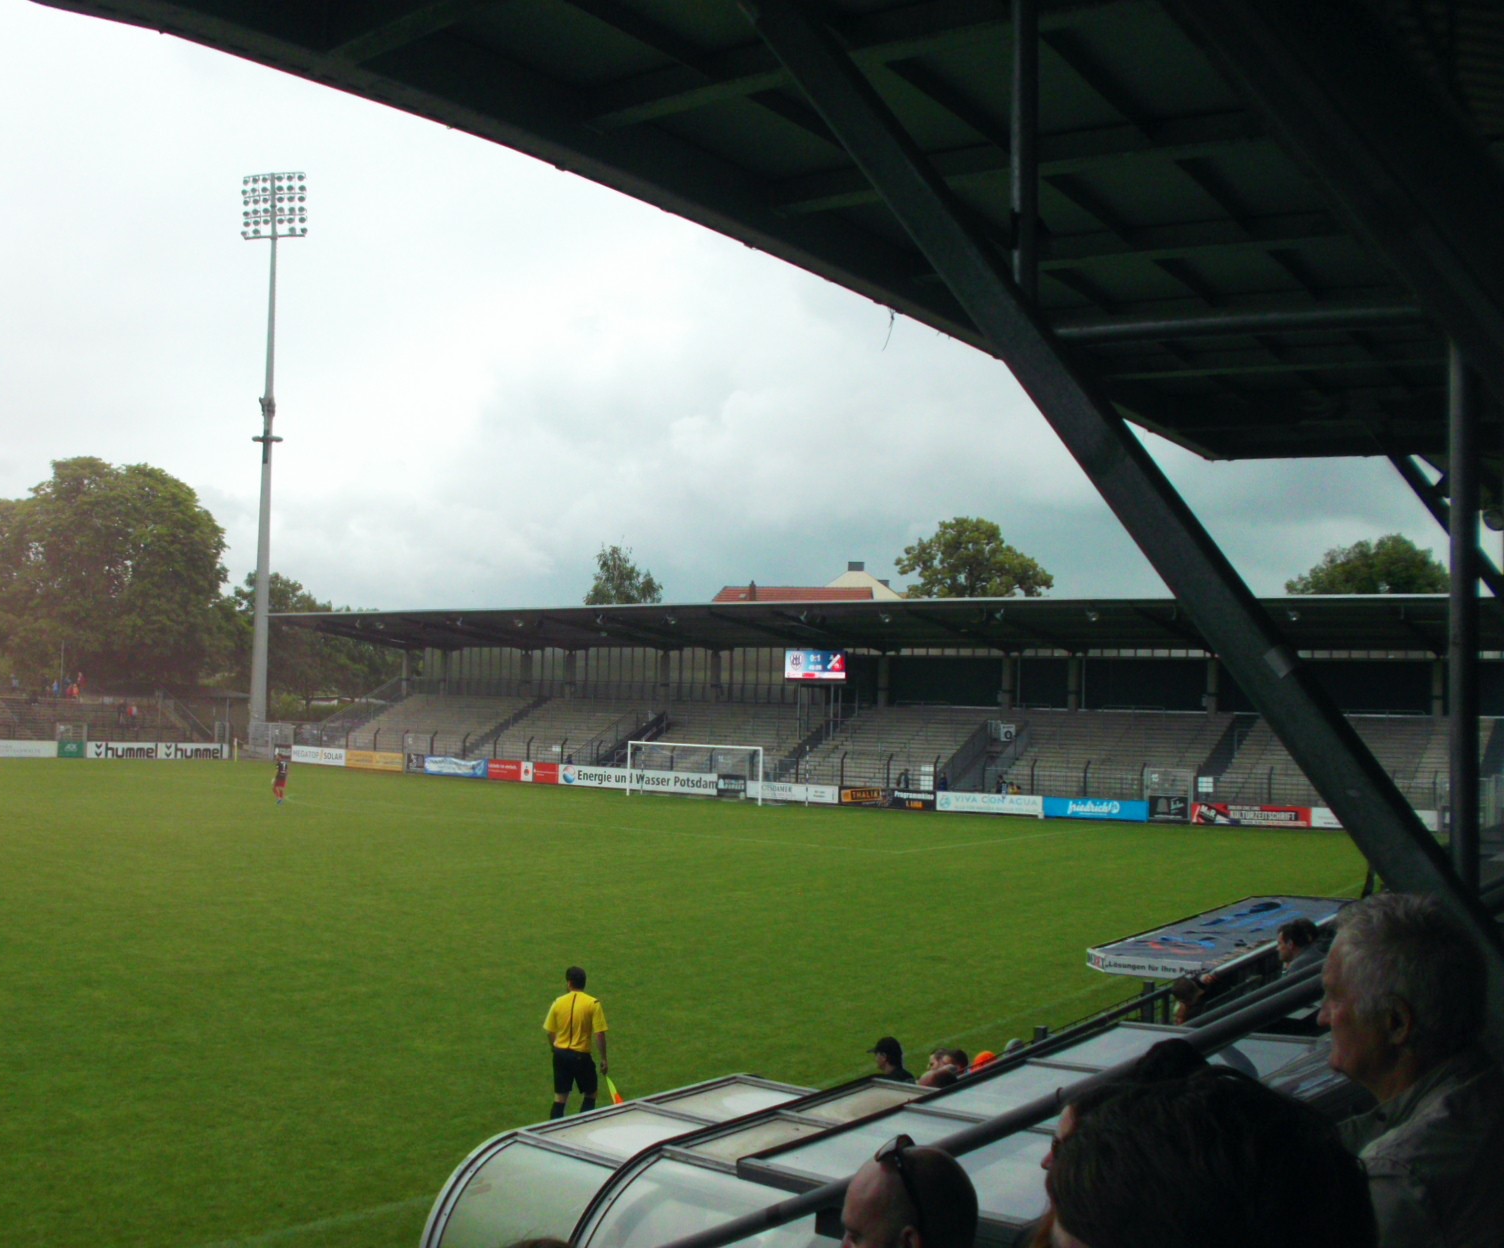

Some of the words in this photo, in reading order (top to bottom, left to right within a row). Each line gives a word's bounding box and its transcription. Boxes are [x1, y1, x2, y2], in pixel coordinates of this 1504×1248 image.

[105, 743, 158, 759] hummel
[323, 752, 343, 761] SOLAR
[577, 769, 612, 785] Energie
[635, 774, 670, 787] Wasser
[674, 776, 718, 790] Potsdam
[852, 789, 880, 800] THALIA
[954, 795, 978, 804] VIVA
